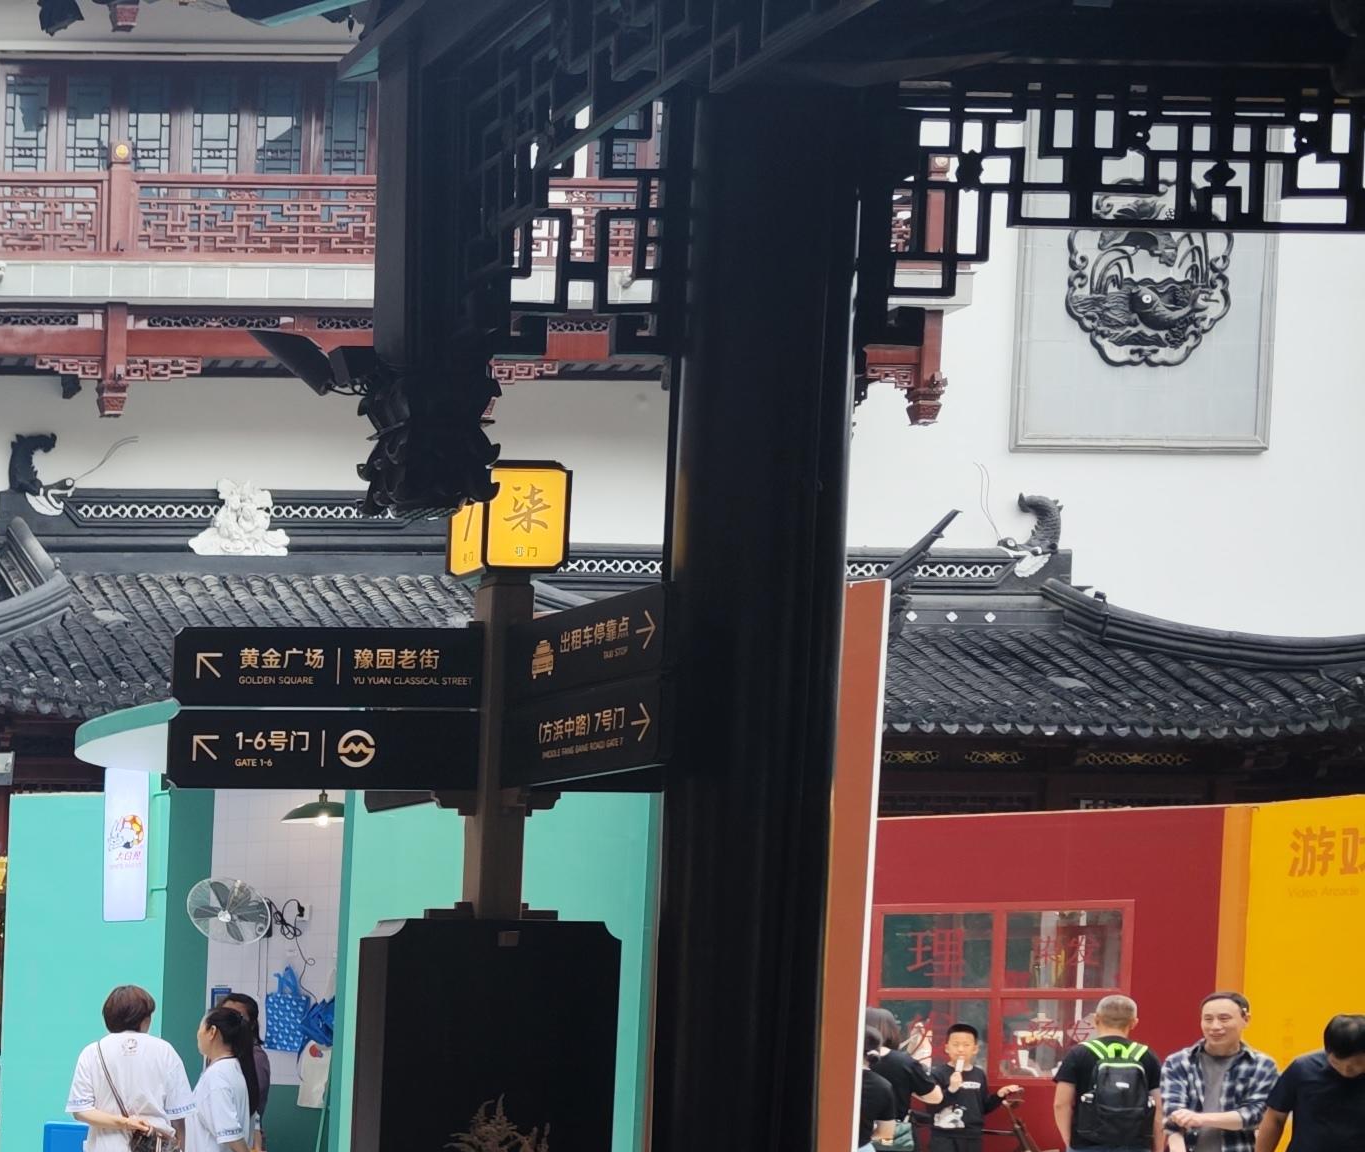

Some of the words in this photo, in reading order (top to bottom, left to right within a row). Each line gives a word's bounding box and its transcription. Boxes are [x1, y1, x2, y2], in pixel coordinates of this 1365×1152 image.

[502, 483, 552, 534] 柒
[559, 616, 630, 653] 出租车停靠点
[239, 648, 325, 670] 黄金广场
[353, 648, 440, 670] 豫园老街
[238, 675, 276, 685] GOLDEN
[278, 675, 314, 685] SQUARE
[353, 676, 366, 685] YU
[367, 676, 392, 685] YUAN
[393, 676, 439, 685] CLASSICAL
[441, 676, 473, 686] STREET
[234, 730, 310, 752] 1-6号门
[235, 758, 257, 767] GATE
[260, 758, 273, 767] 1-6
[906, 928, 966, 977] 理
